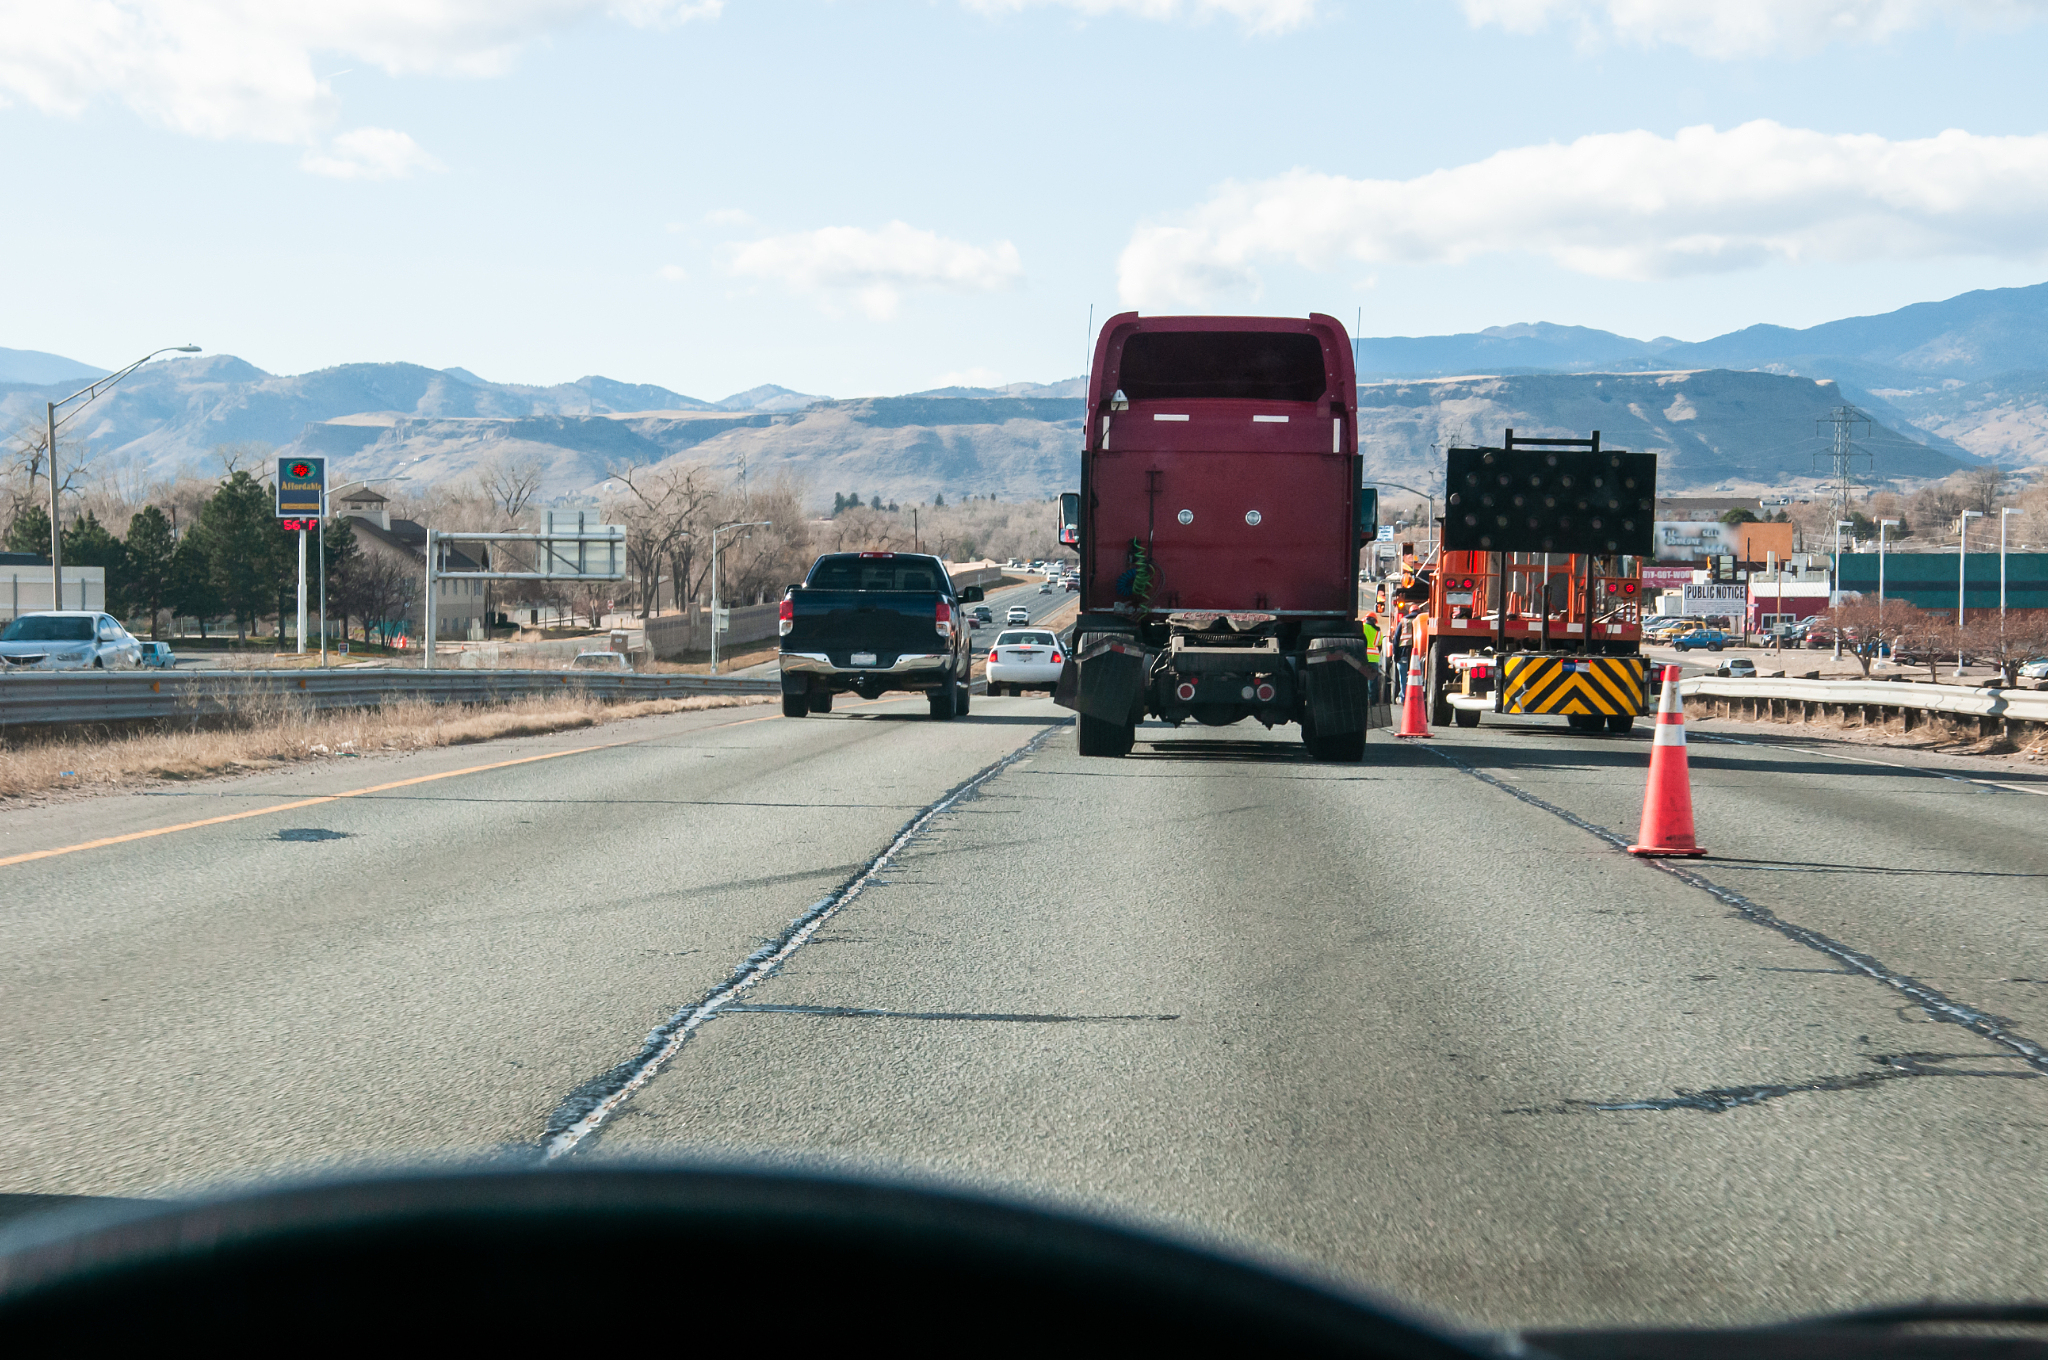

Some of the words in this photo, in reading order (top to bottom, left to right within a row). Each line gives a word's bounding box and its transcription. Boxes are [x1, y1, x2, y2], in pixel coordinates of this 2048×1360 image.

[281, 481, 322, 490] Affordable
[1687, 585, 1714, 599] PUBLIC
[1716, 585, 1744, 599] NOTICE
